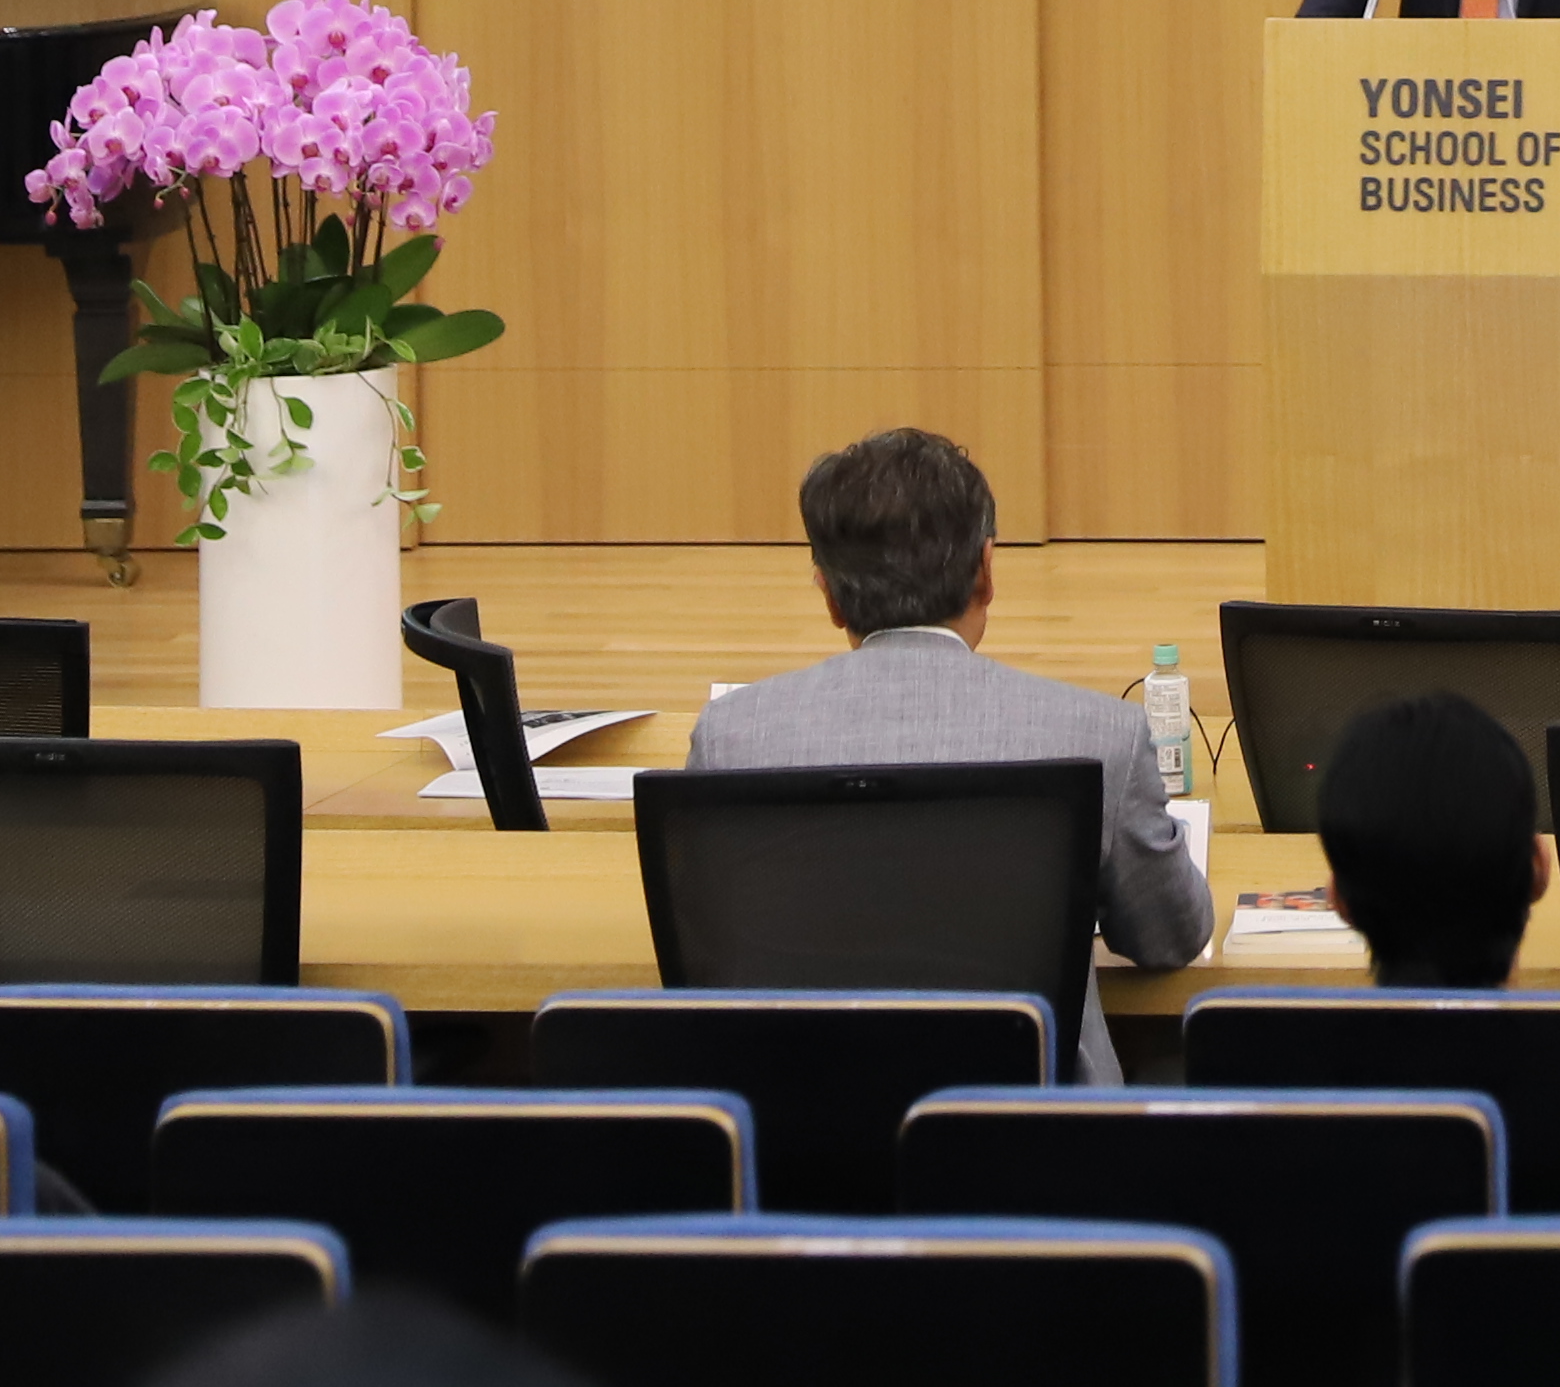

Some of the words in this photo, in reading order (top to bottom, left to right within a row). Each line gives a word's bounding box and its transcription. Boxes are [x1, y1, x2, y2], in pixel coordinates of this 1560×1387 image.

[1359, 78, 1524, 119] YONSEI
[1359, 130, 1507, 167] SCHOOL
[1359, 176, 1546, 214] BUSINESS
